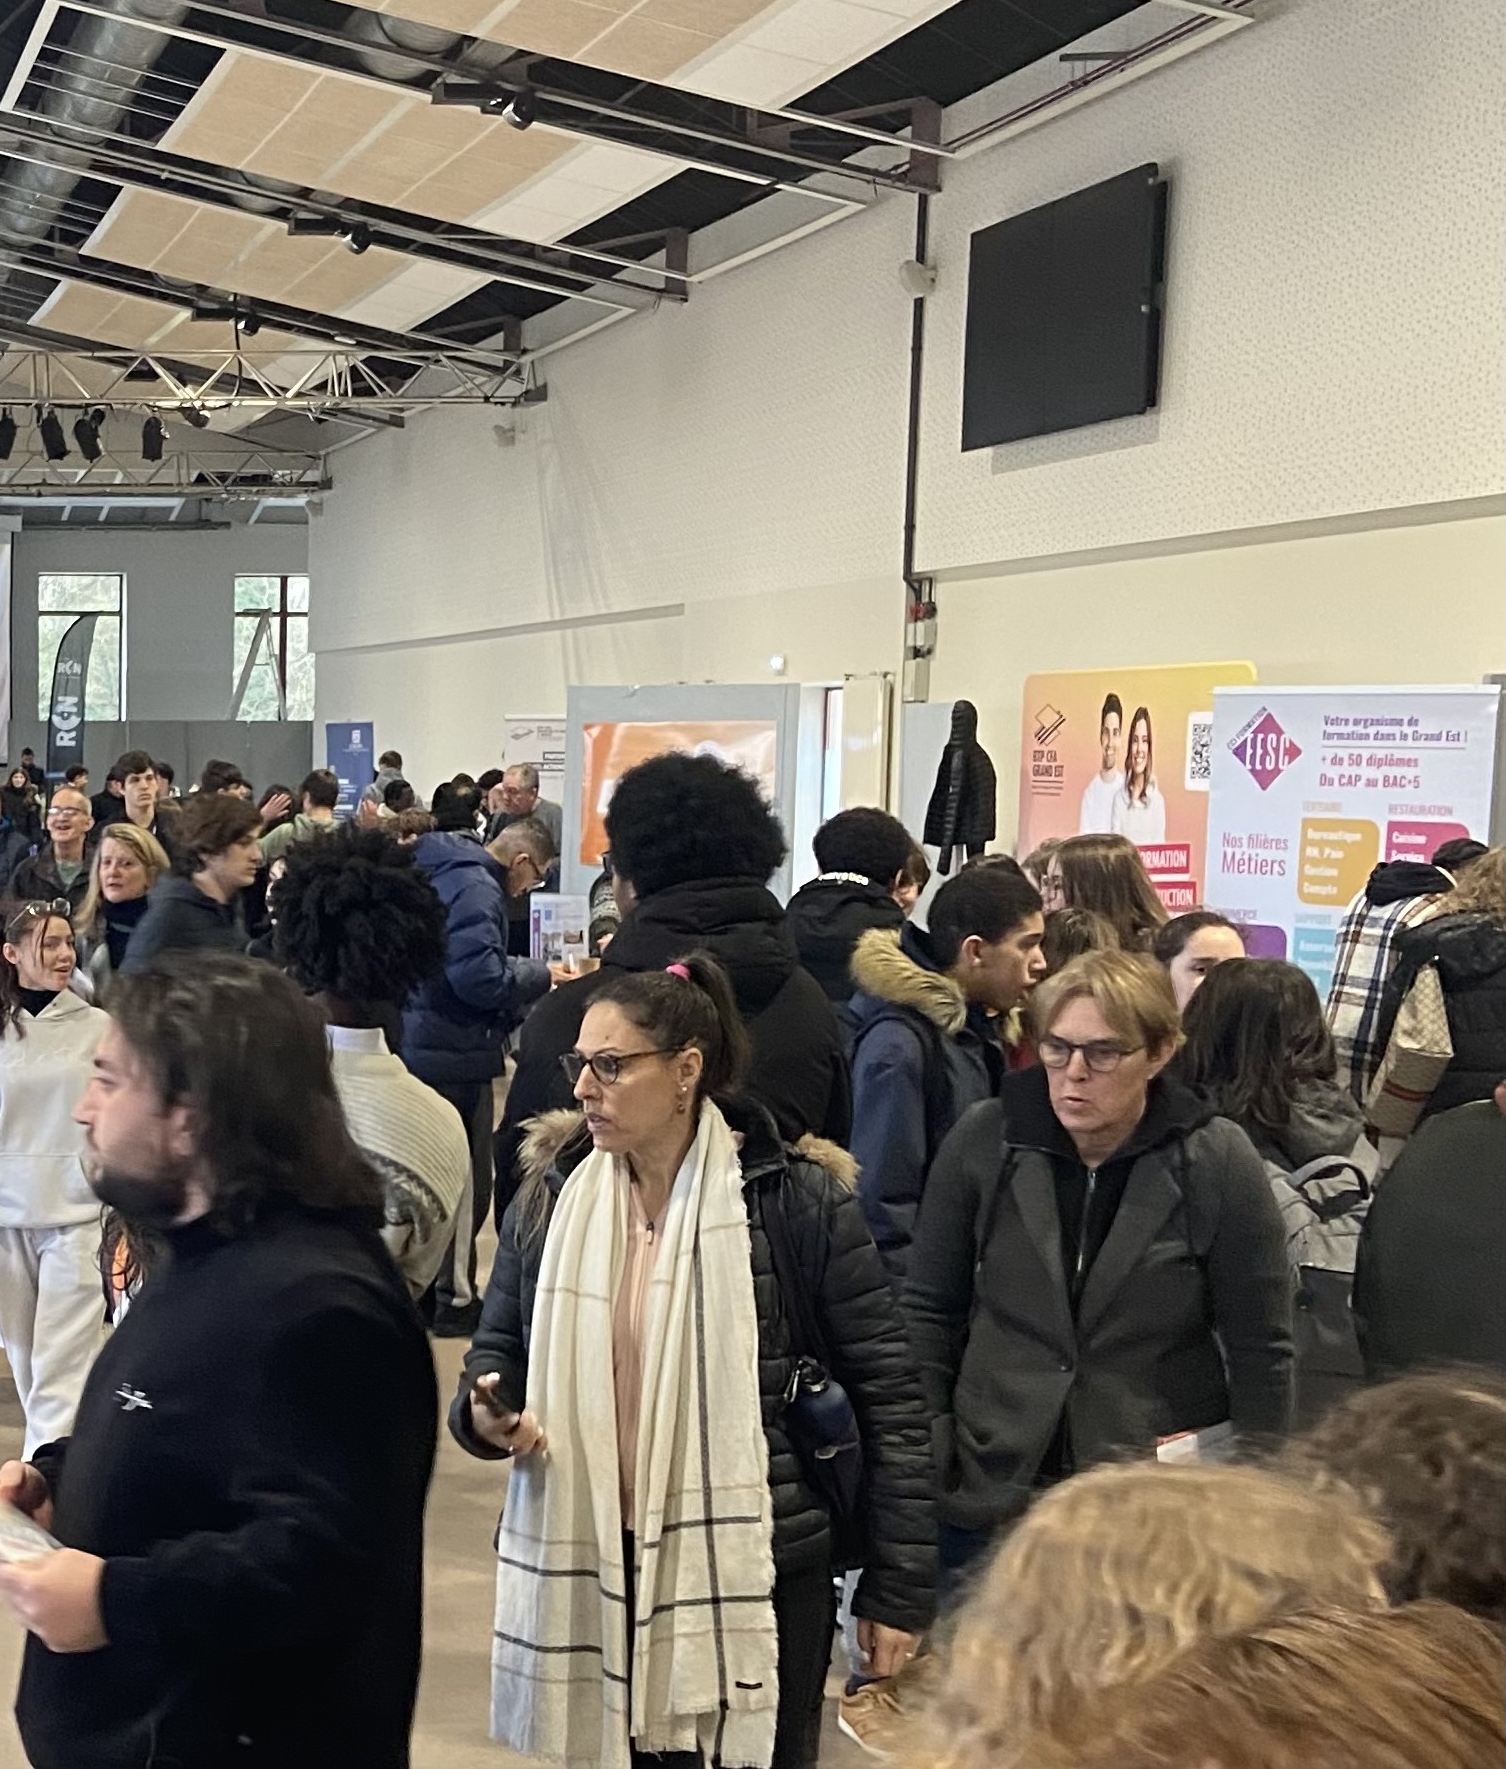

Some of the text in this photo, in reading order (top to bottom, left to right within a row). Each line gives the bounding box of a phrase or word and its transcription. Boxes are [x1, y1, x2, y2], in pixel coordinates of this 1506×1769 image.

[1323, 715, 1419, 729] Votre organisme de
[1322, 730, 1370, 741] formation
[1373, 730, 1396, 742] dans
[1399, 730, 1408, 742] le
[1412, 730, 1443, 742] Grand
[1445, 731, 1461, 742] Est
[1245, 732, 1290, 771] EESC
[1331, 754, 1344, 767] de
[1348, 754, 1363, 767] 50
[1366, 753, 1419, 769] diplômes
[1032, 765, 1064, 777] GRAND EST
[1319, 773, 1334, 787] Du
[1338, 774, 1361, 787] CAP
[1365, 777, 1378, 788] au
[1388, 804, 1454, 817] RESTAURATION
[1222, 832, 1289, 850] Nos filières
[1140, 850, 1187, 868] ORMATION
[1221, 851, 1287, 876] Métiers
[1160, 888, 1194, 906] UCTION
